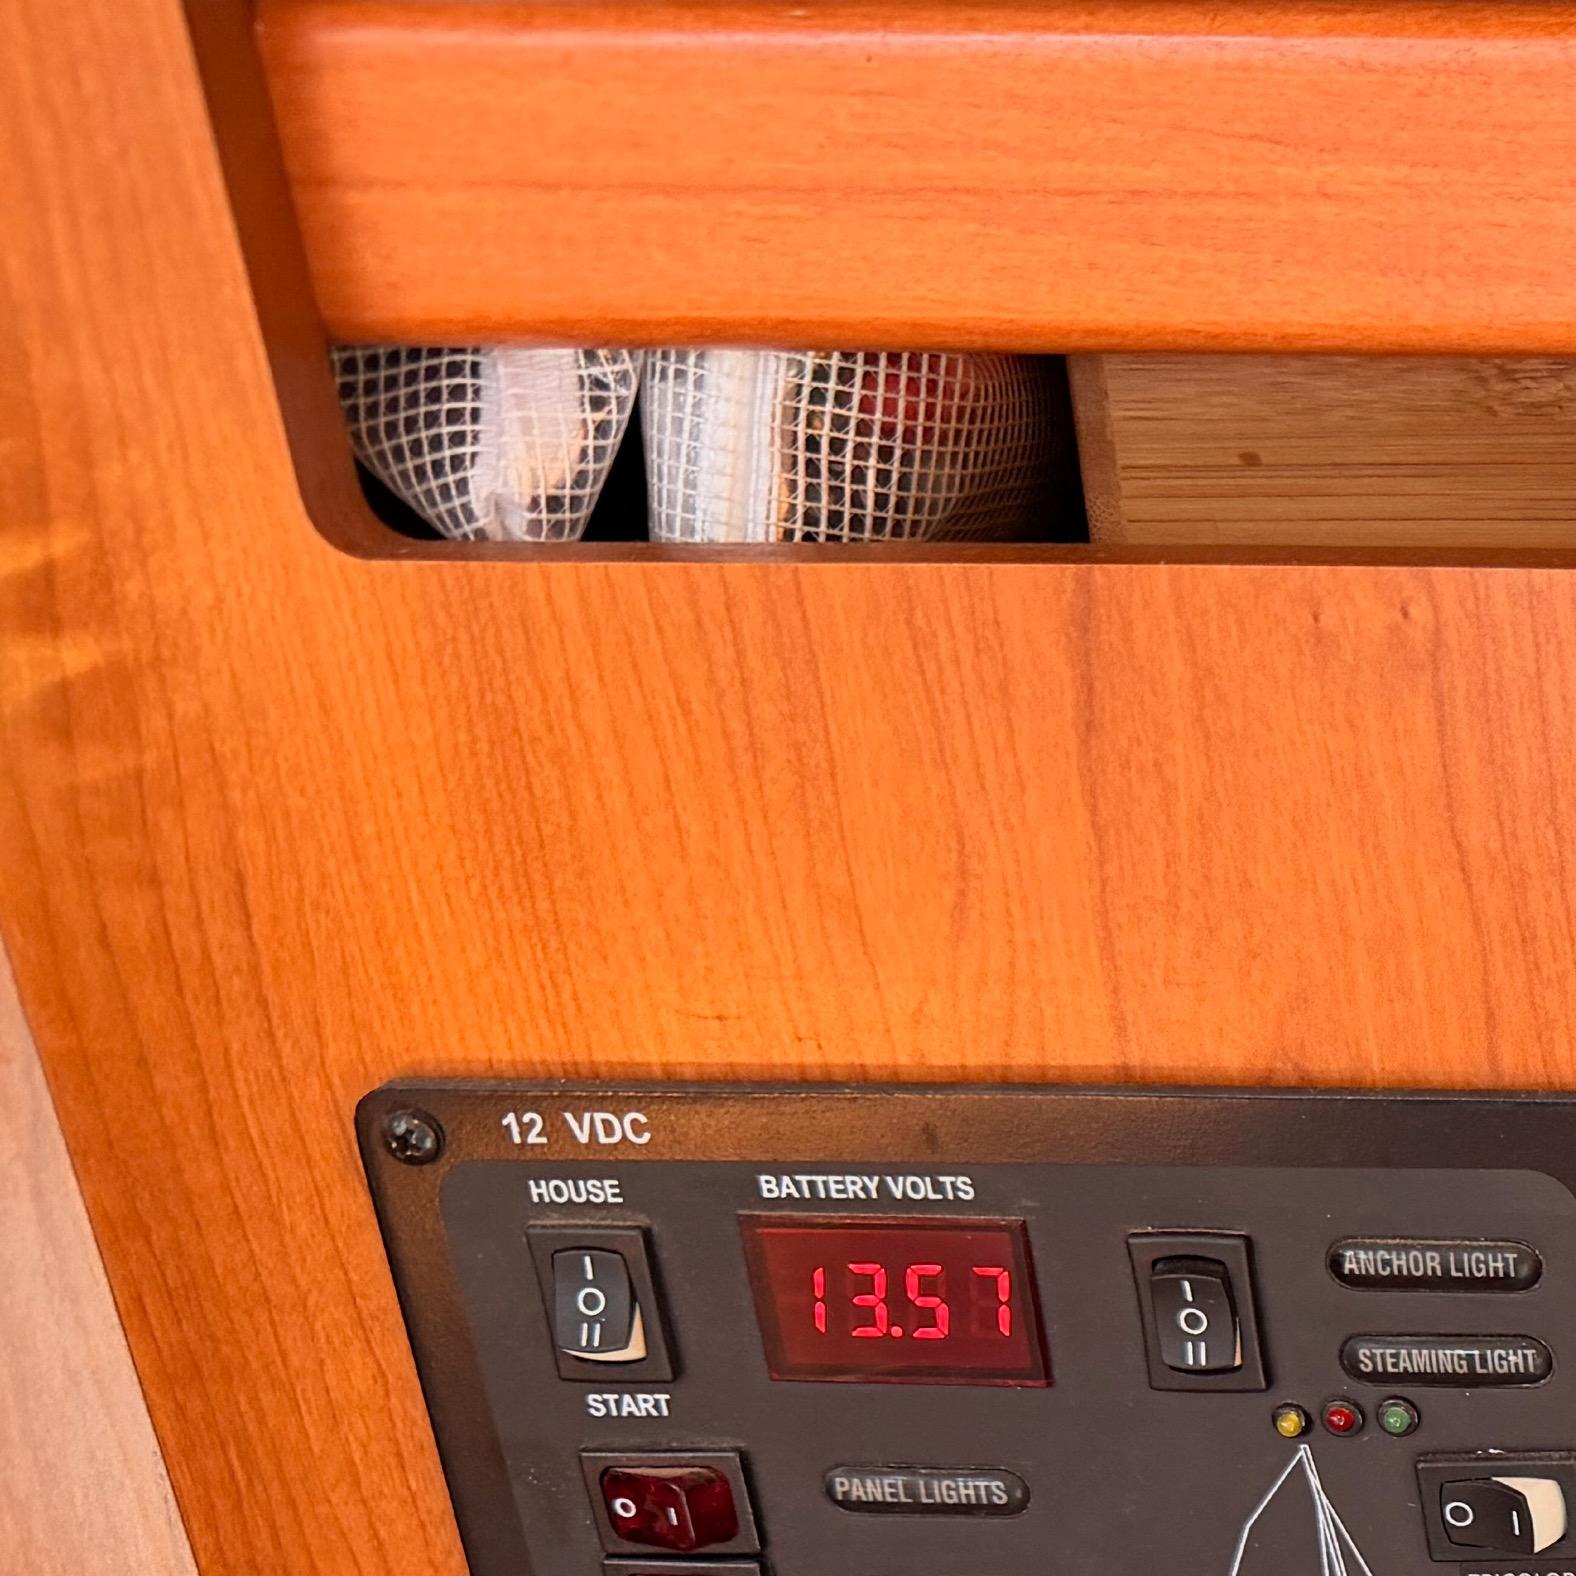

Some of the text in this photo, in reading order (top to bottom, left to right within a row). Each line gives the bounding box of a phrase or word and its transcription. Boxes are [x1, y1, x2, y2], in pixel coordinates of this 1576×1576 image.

[501, 1112, 651, 1145] 12 VDC
[529, 1179, 623, 1203] HOUSE
[759, 1174, 975, 1200] BATTERY VOLTS
[1343, 1250, 1518, 1279] ANCHOR LIGHT
[812, 1264, 1011, 1339] 13.57
[1358, 1348, 1536, 1374] STEAMING LIGHT
[587, 1394, 670, 1416] START
[834, 1477, 1008, 1505] PANEL LIGHTS
